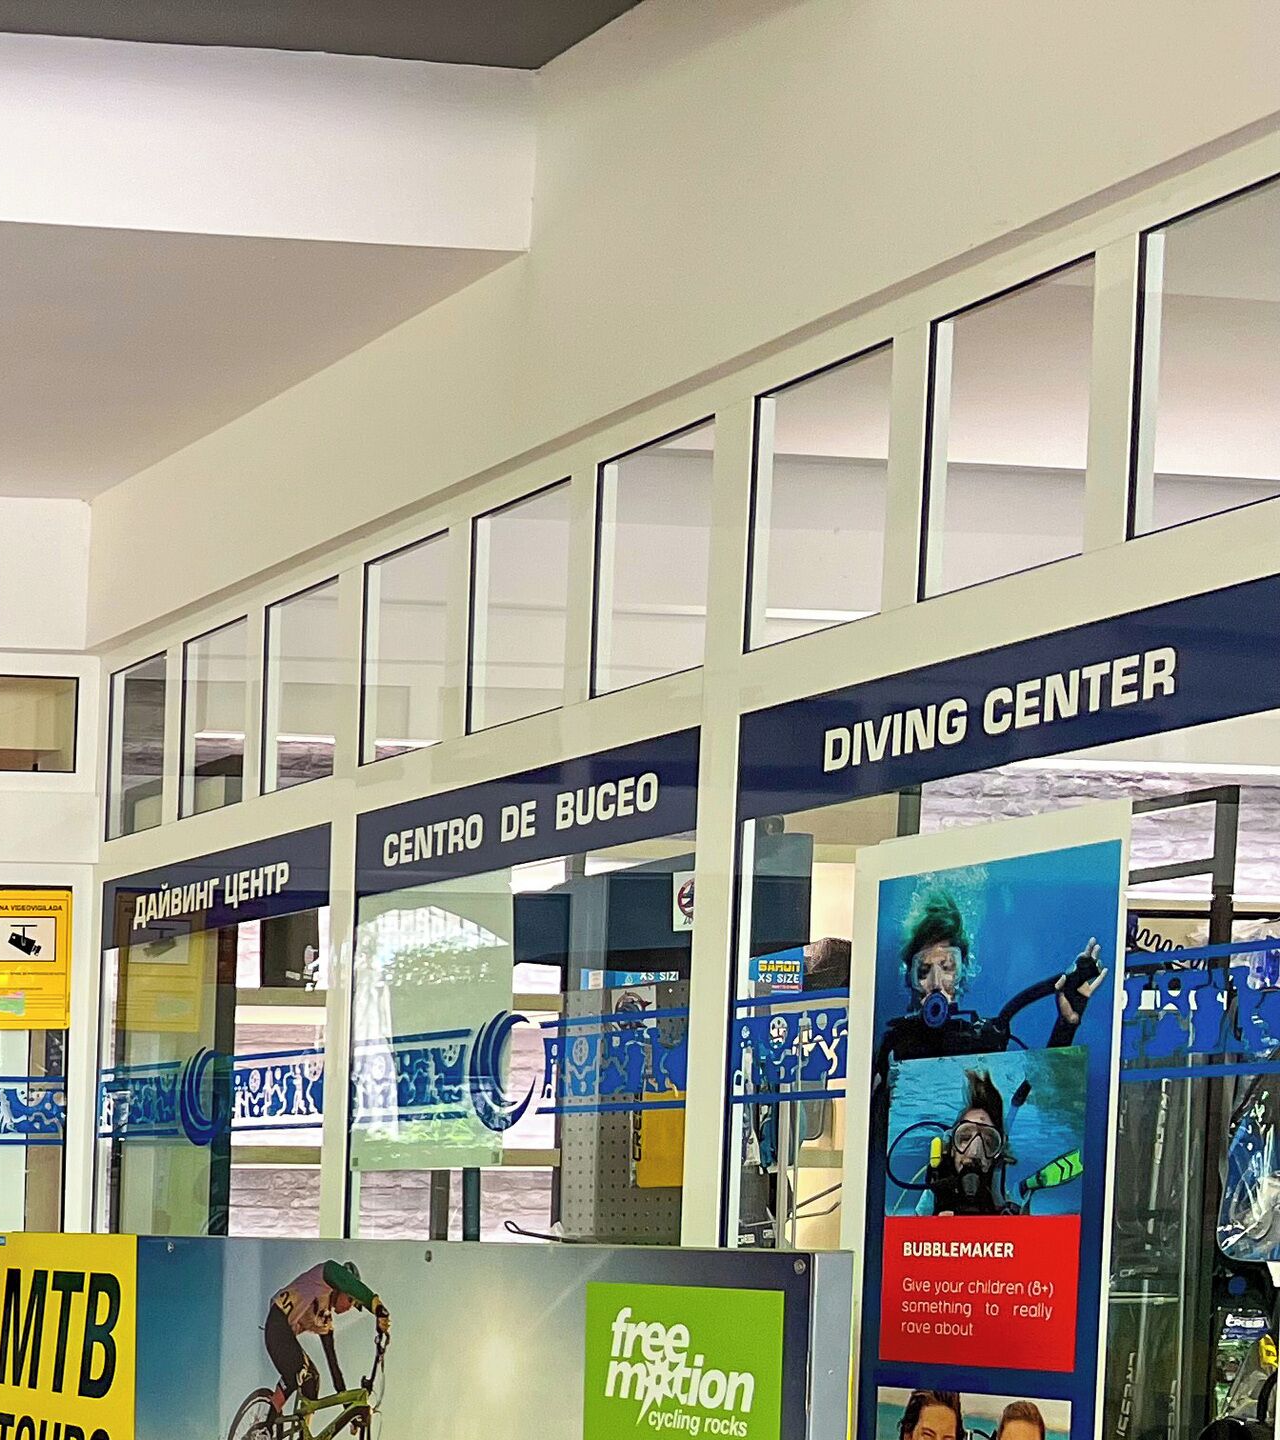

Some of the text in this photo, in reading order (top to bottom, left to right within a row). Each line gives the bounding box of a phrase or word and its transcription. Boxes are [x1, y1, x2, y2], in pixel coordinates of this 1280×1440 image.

[823, 647, 1177, 772] DIVING CENTER
[383, 772, 659, 867] CENTRO DE BUCEO
[133, 862, 289, 930] ДАЙВИНГ ЦЕНТР
[758, 973, 800, 983] XS SIZE
[903, 1241, 1014, 1257] BUBBLEMAKER
[902, 1277, 1054, 1297] Give your children (8+)
[901, 1300, 1053, 1320] something to really
[611, 1307, 690, 1363] free
[901, 1322, 973, 1336] rave about
[604, 1354, 755, 1413] motion
[648, 1409, 748, 1437] cycling rocks
